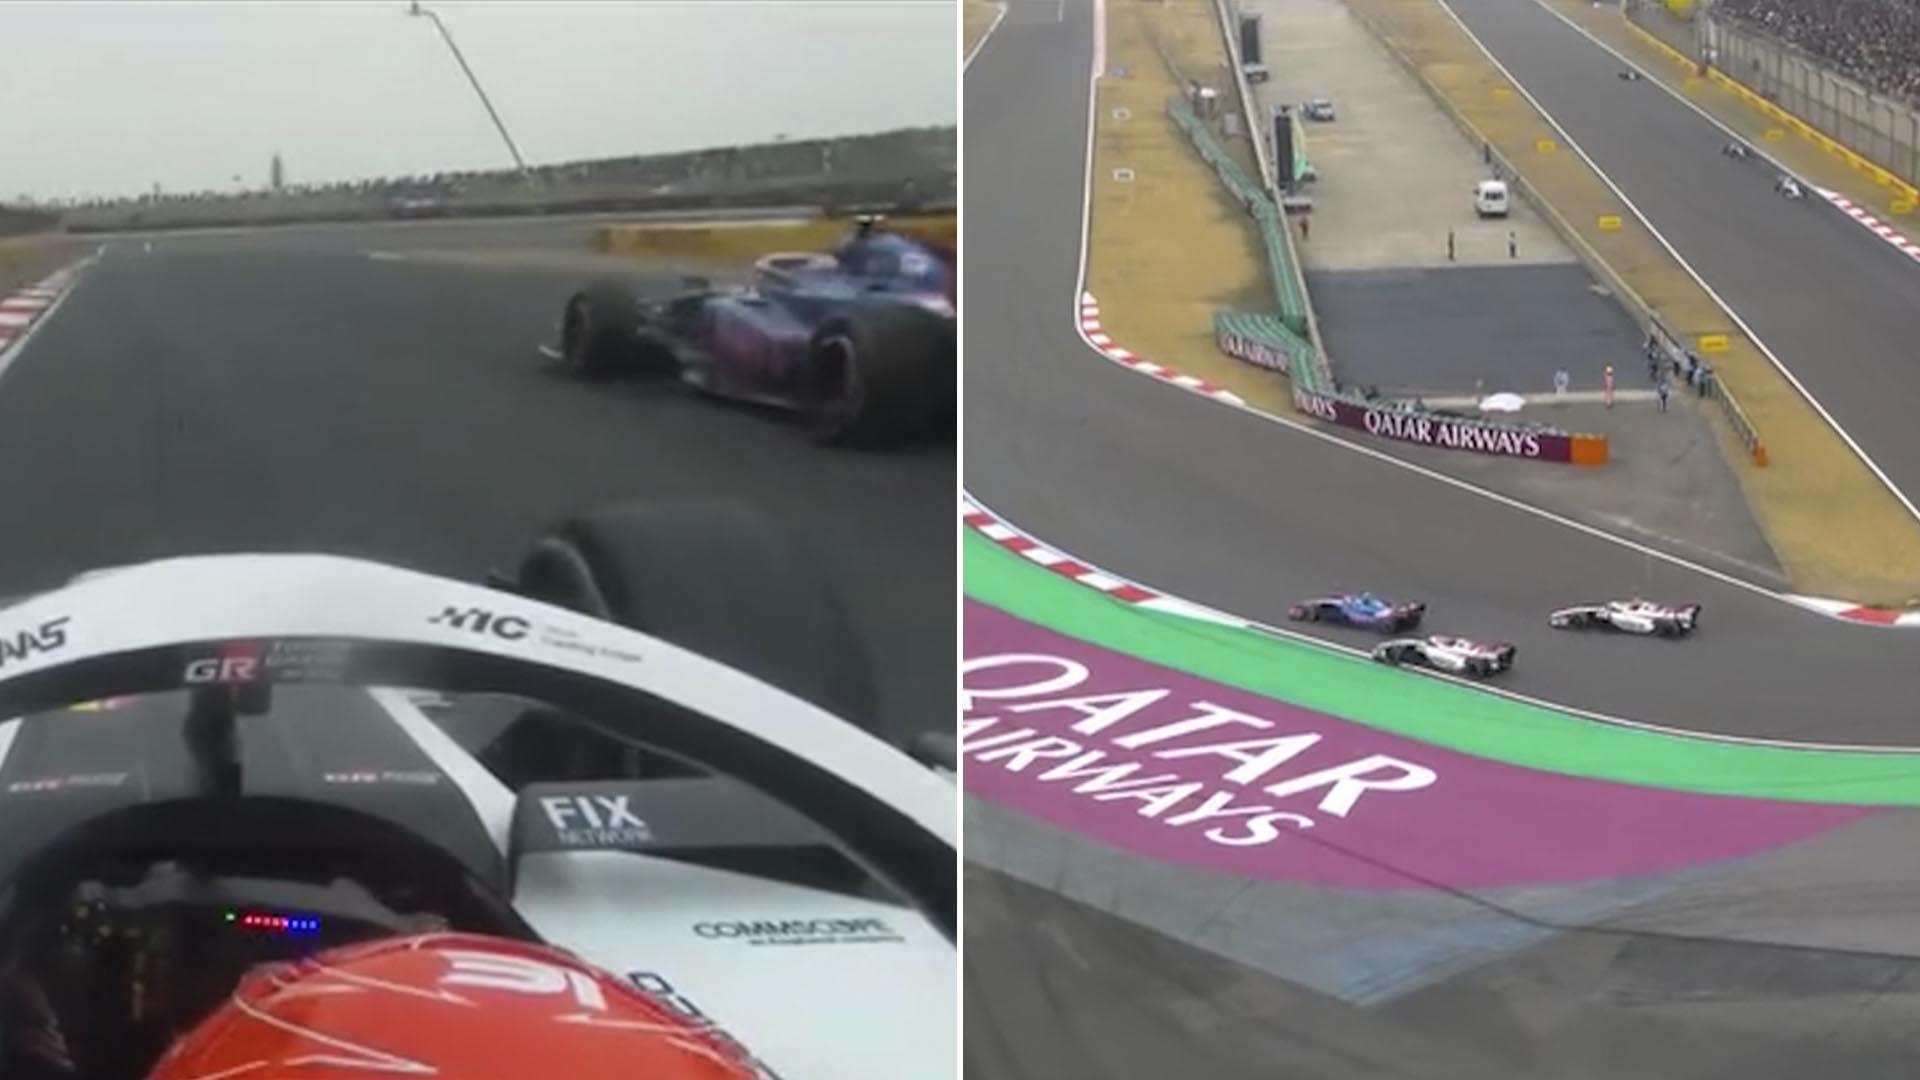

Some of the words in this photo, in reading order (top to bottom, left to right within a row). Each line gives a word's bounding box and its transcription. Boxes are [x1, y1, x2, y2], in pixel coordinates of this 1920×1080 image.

[1363, 410, 1432, 444] QATAR
[1436, 423, 1541, 457] AIRWAYS
[184, 656, 257, 684] GR
[963, 653, 1437, 818] QATAR
[540, 796, 646, 829] FIX
